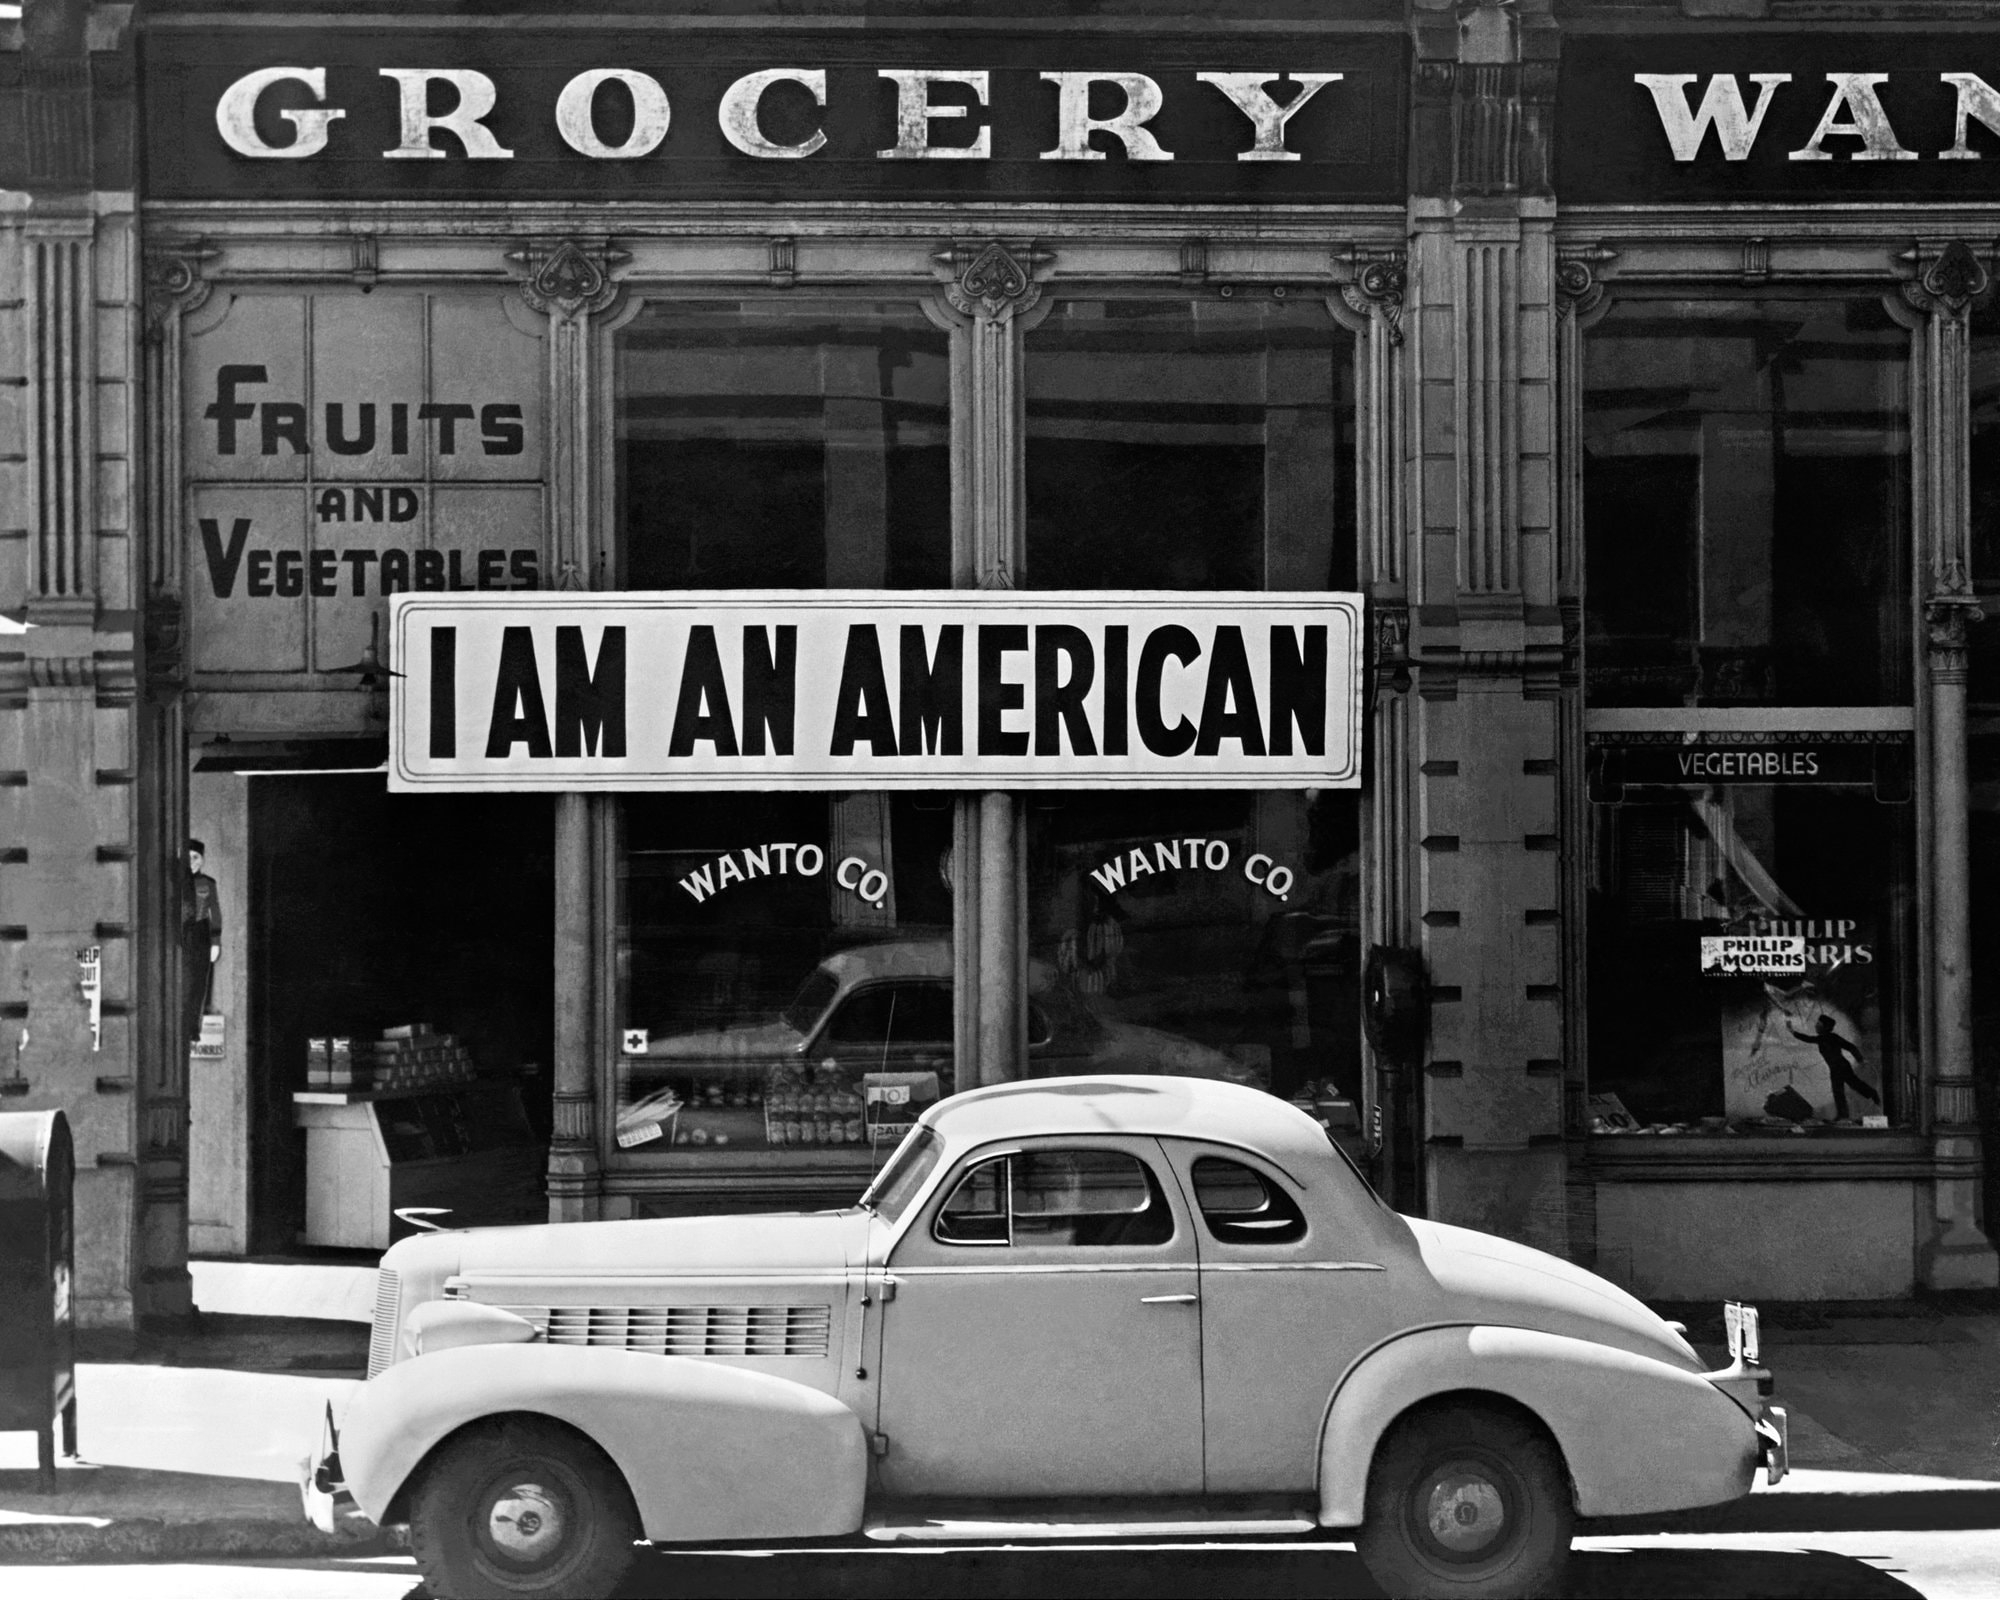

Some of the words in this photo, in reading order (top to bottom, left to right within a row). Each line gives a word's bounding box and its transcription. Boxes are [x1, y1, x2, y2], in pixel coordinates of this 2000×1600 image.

[215, 66, 1344, 162] GROCERY
[316, 487, 420, 523] AND
[199, 517, 539, 599] VEGETABLES
[429, 626, 457, 759] I
[485, 625, 627, 759] AM
[668, 624, 798, 758] AN
[829, 623, 1328, 758] AMERICAN
[1679, 752, 1819, 776] VEGETABLES
[679, 842, 824, 903] WANTO
[836, 856, 889, 909] CO.
[1090, 838, 1230, 894] WANTO
[1244, 853, 1294, 902] CO.
[77, 948, 99, 963] HELP
[1722, 940, 1794, 952] PHILIP
[1722, 953, 1803, 967] MORRIS
